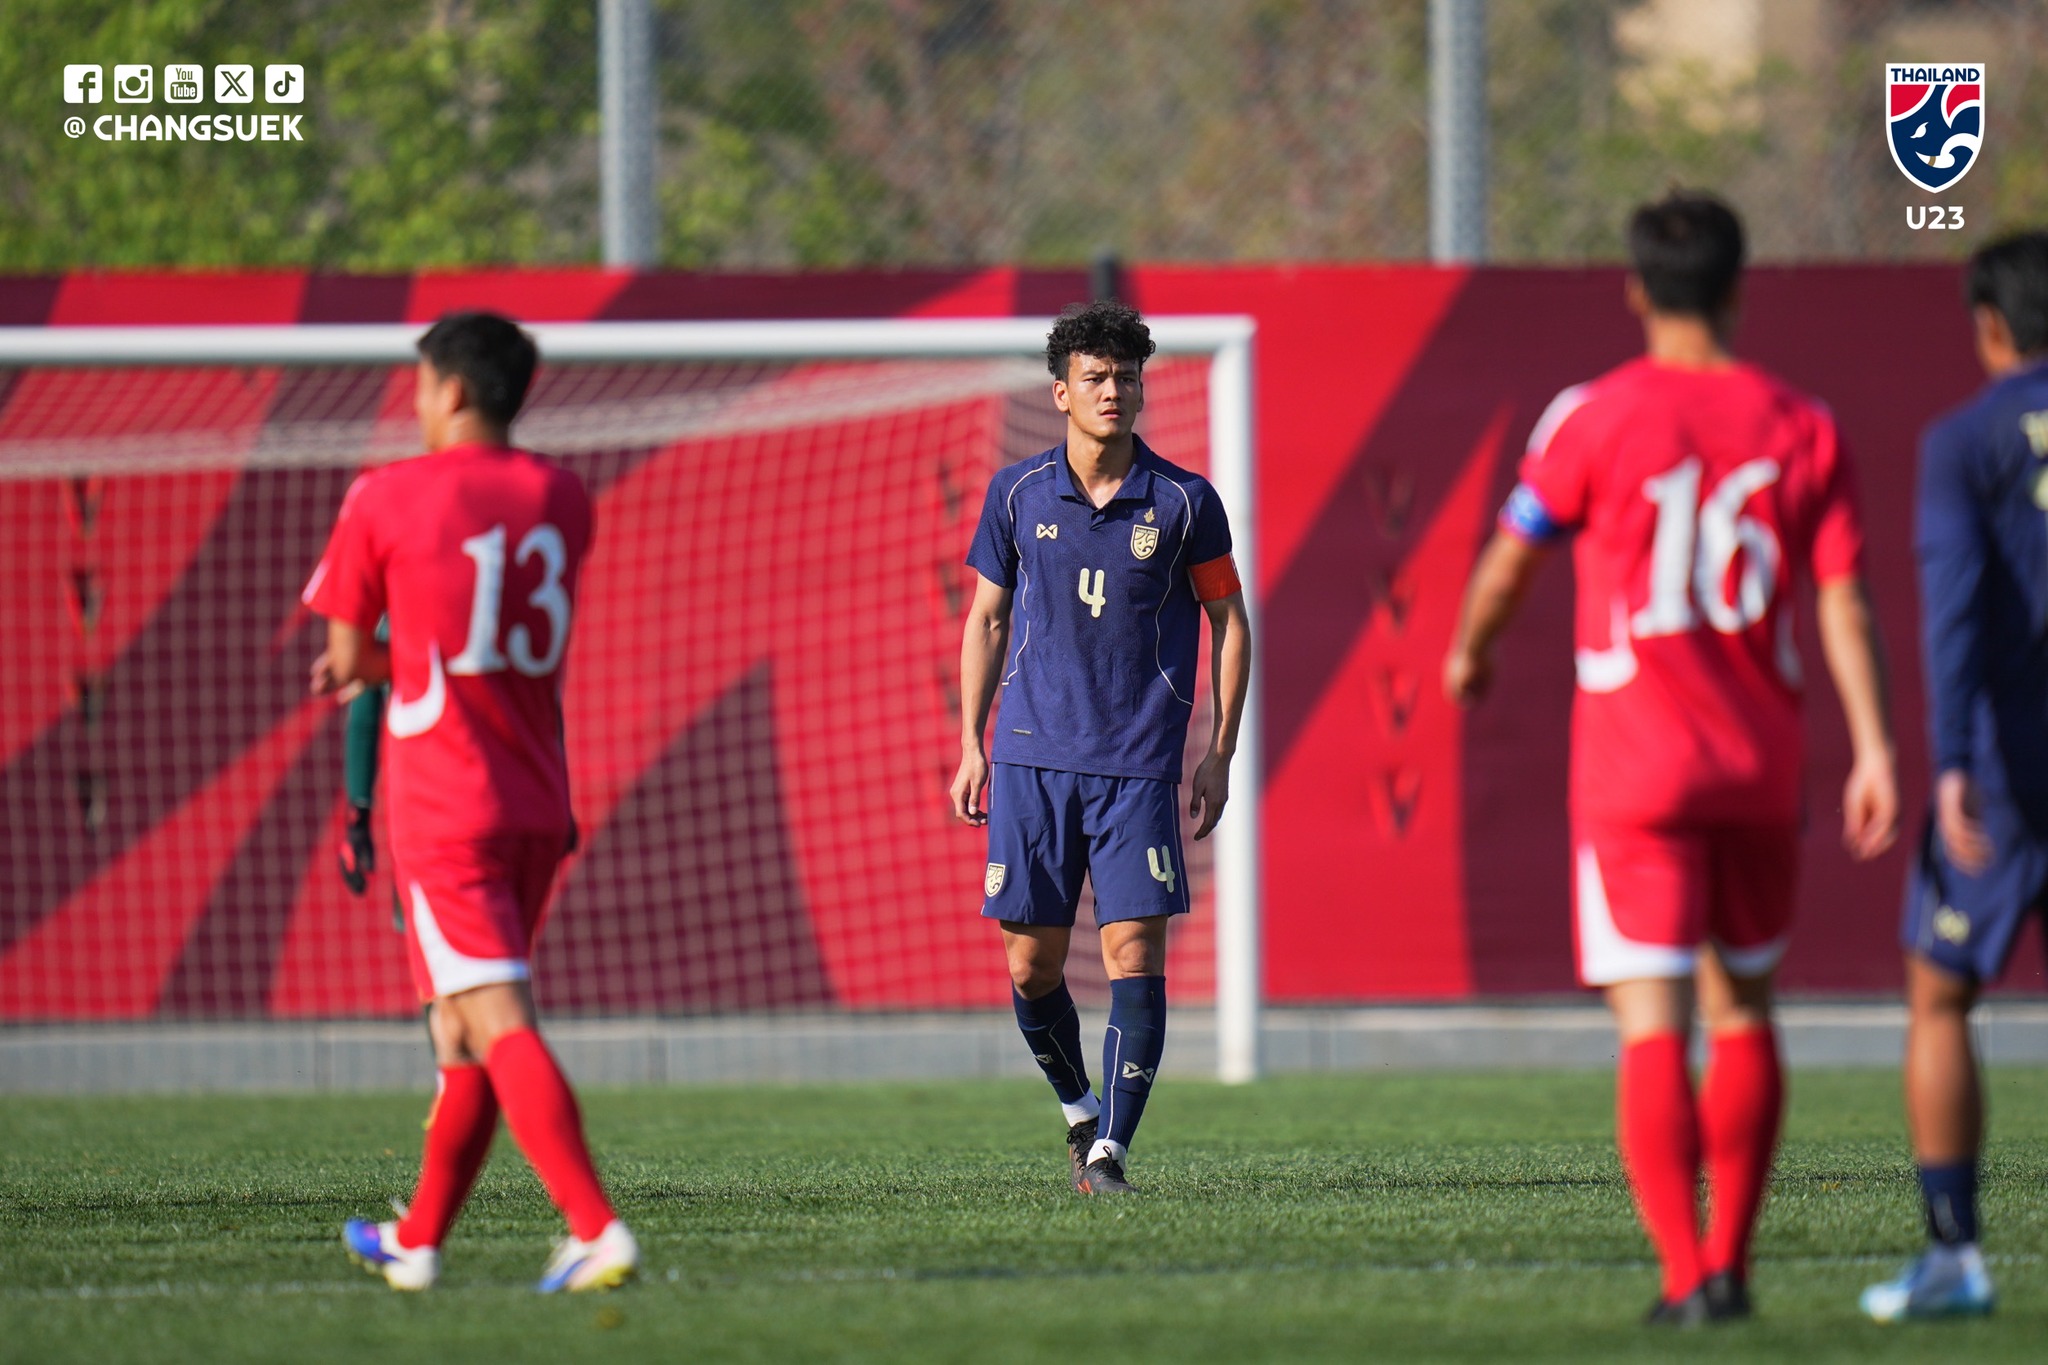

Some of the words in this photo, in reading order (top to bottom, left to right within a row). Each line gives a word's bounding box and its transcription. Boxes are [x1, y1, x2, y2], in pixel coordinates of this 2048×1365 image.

[1078, 568, 1106, 617] 4
[1630, 455, 1781, 639] 16
[446, 522, 573, 678] 13
[1147, 845, 1175, 893] 4
